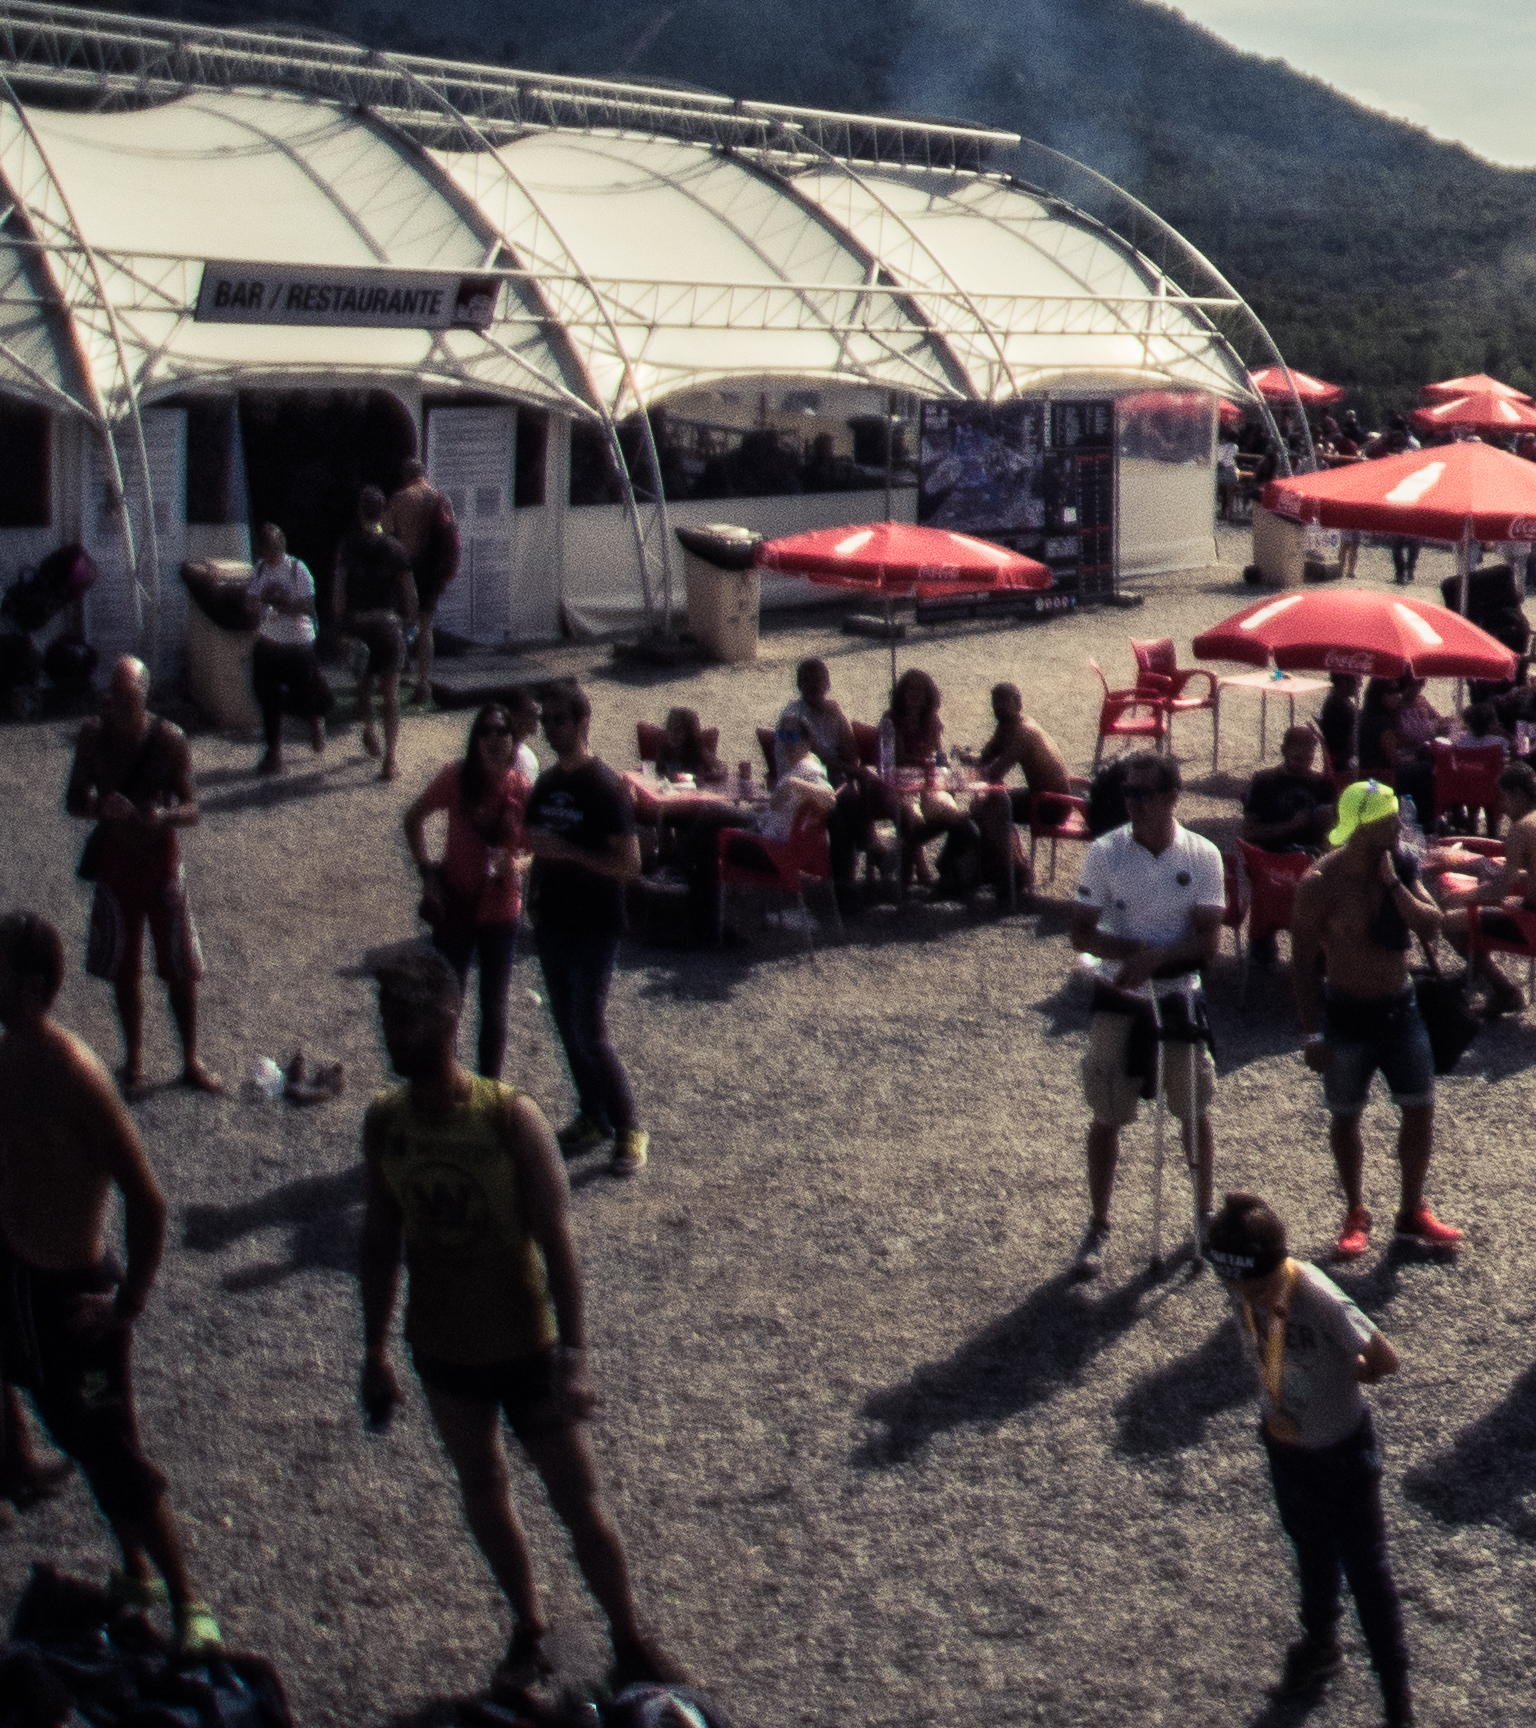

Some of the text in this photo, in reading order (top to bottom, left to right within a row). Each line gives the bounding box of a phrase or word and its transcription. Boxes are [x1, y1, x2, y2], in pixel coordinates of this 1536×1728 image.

[214, 279, 444, 316] BAR / RESTAURANTE
